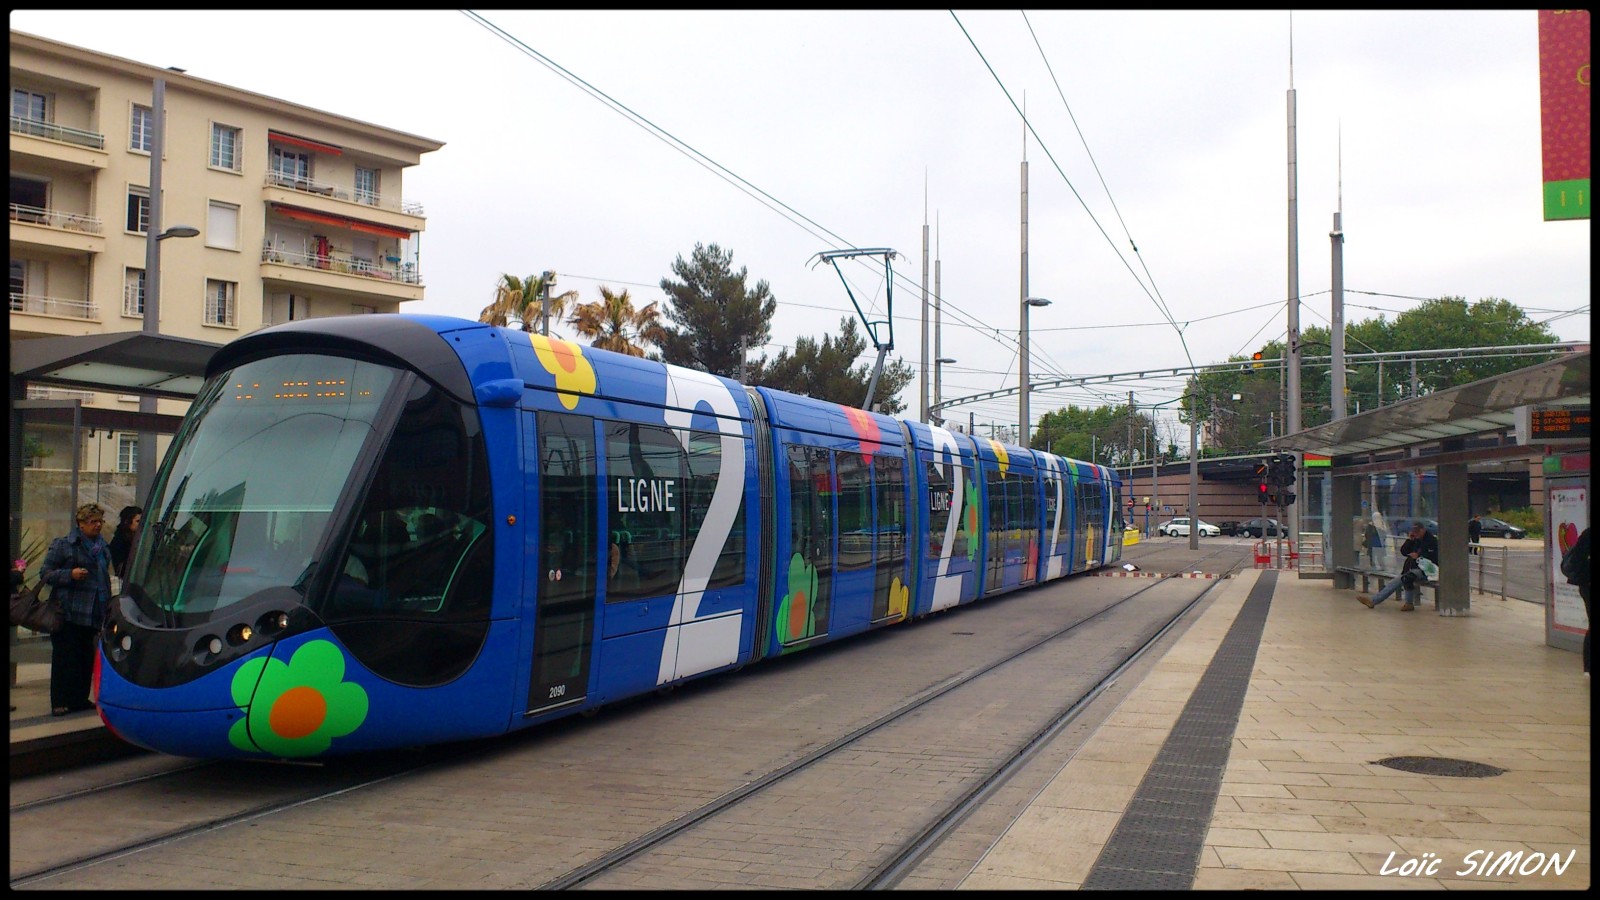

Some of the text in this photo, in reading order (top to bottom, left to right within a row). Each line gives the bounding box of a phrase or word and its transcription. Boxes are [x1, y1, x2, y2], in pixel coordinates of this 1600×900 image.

[617, 363, 746, 686] LIGNE 2
[930, 424, 964, 613] LIGNE 2
[549, 684, 566, 698] 2090
